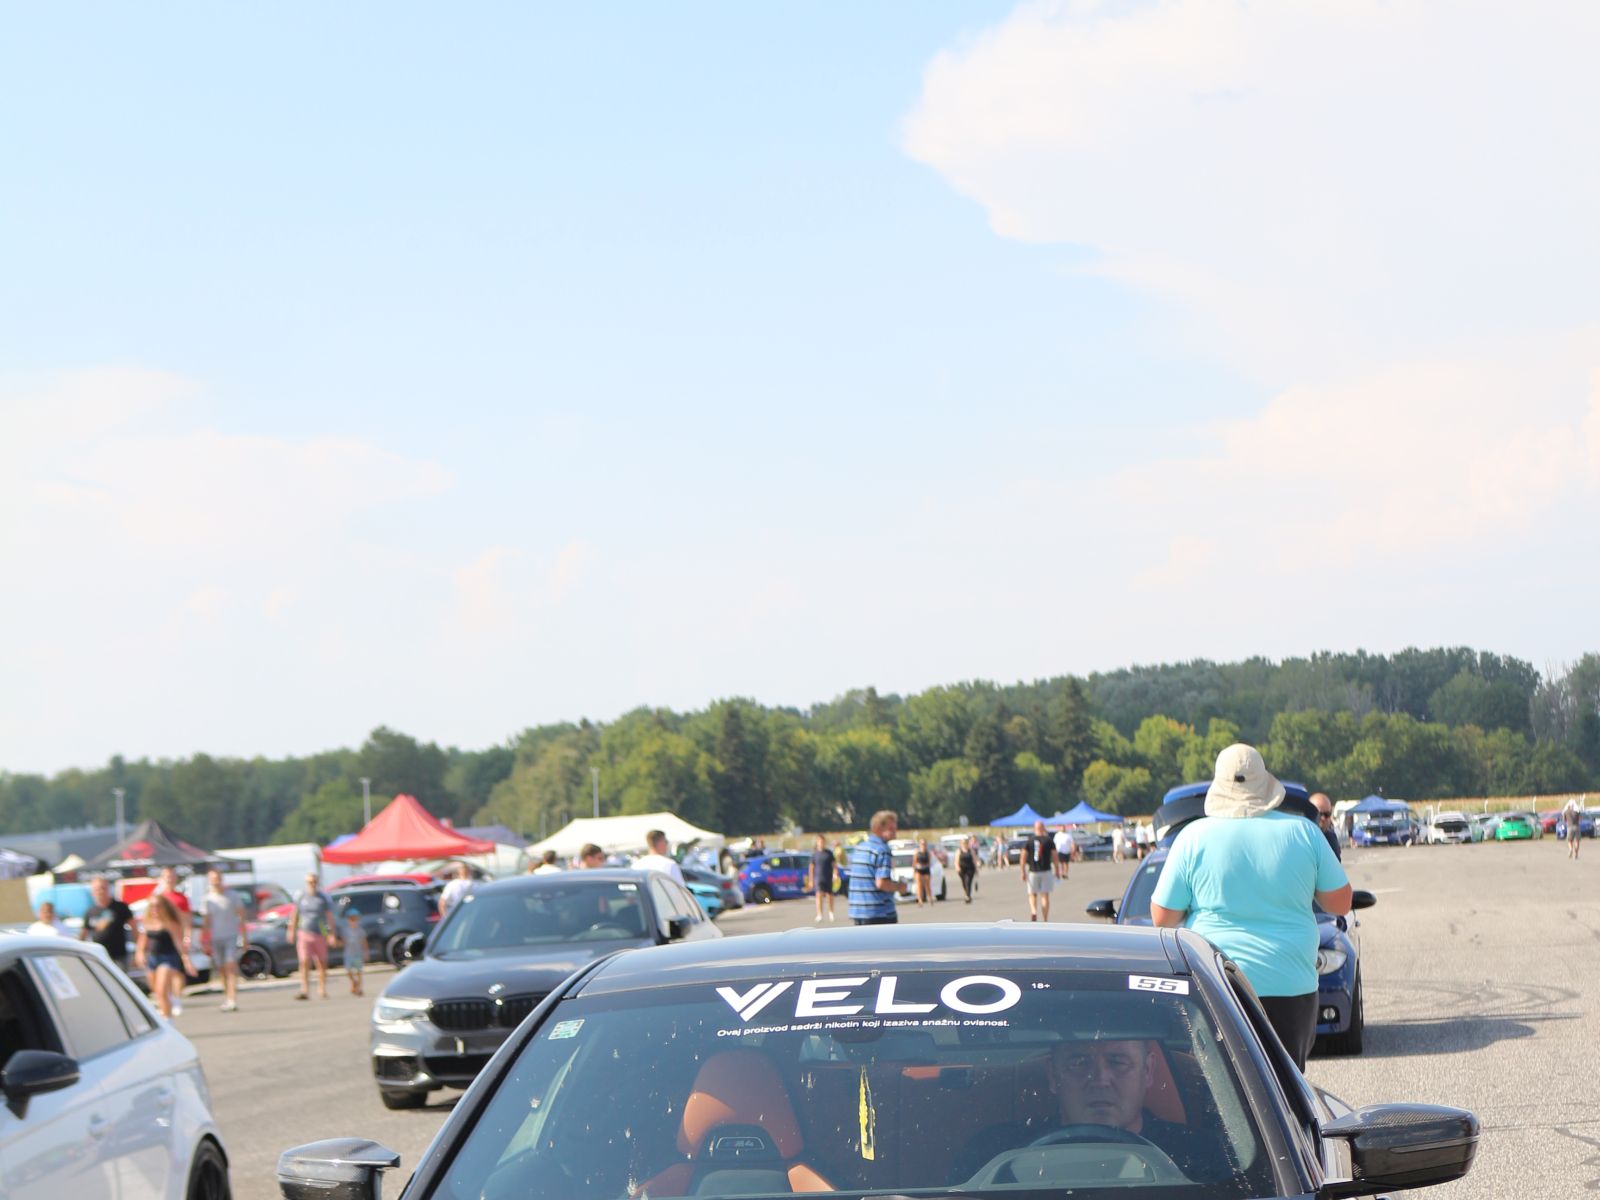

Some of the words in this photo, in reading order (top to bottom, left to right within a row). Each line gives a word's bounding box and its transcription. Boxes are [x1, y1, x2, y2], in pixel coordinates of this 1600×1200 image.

[715, 975, 1022, 1023] VELO
[717, 1028, 741, 1037] Ovaj
[743, 1024, 788, 1036] proizvod
[790, 1022, 822, 1031] sadrži
[824, 1020, 859, 1029] nikotin
[862, 1019, 881, 1028] koji
[882, 1019, 919, 1027] izaziva
[922, 1018, 961, 1027] snažnu
[963, 1018, 1010, 1027] ovisnost.
